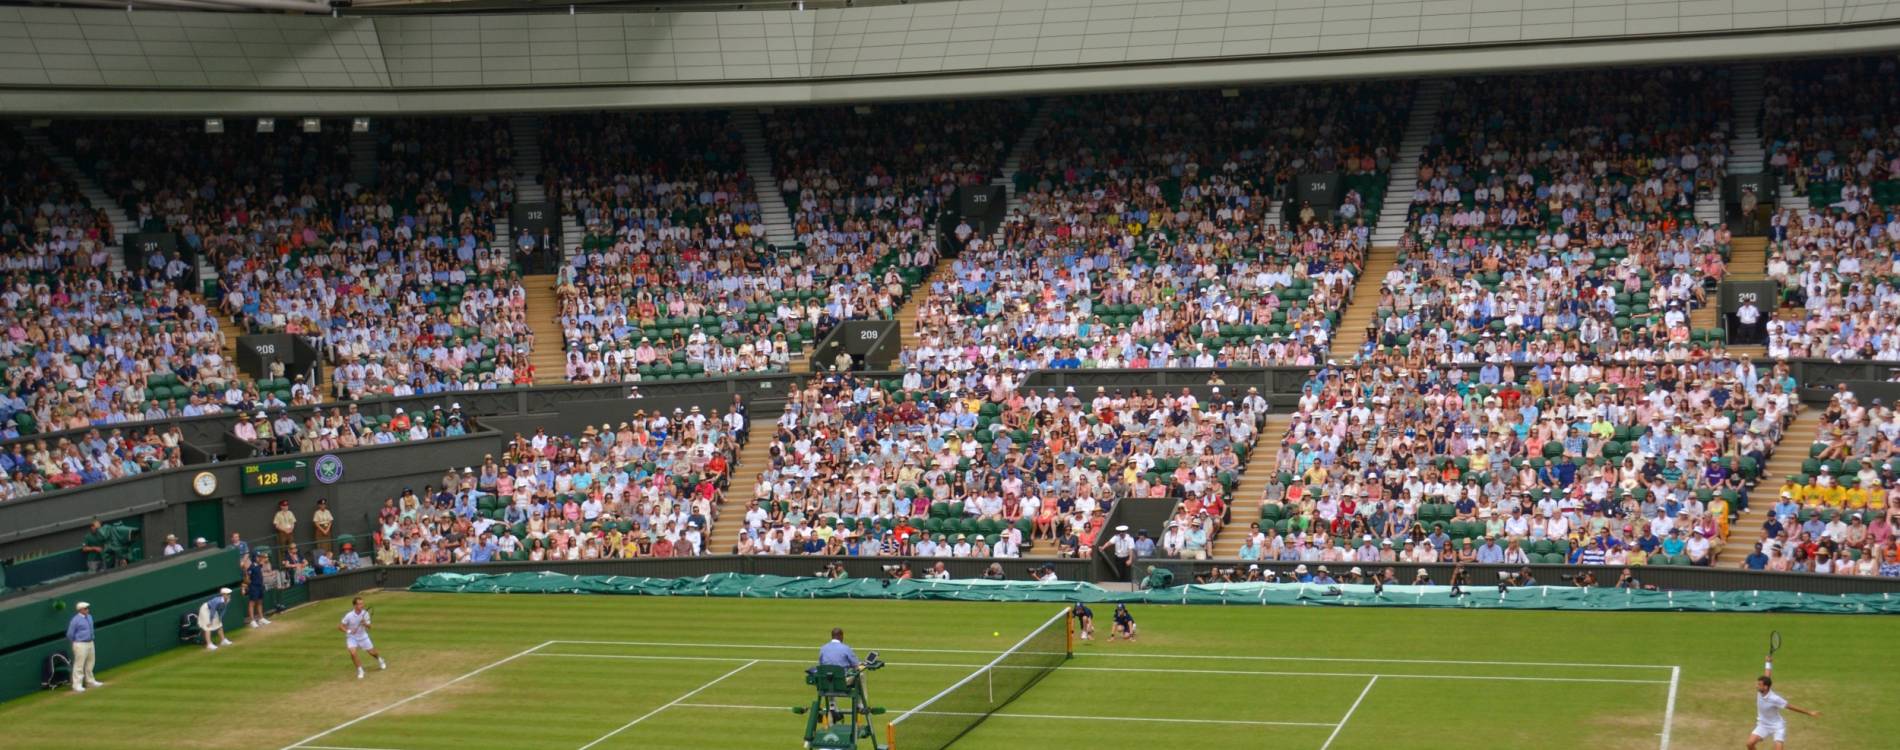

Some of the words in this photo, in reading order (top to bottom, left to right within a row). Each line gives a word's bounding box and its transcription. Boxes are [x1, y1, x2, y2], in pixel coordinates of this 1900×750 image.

[1311, 182, 1326, 191] 314
[528, 210, 543, 219] 312
[860, 330, 878, 339] 209
[257, 473, 279, 485] 128
[281, 475, 297, 484] mph
